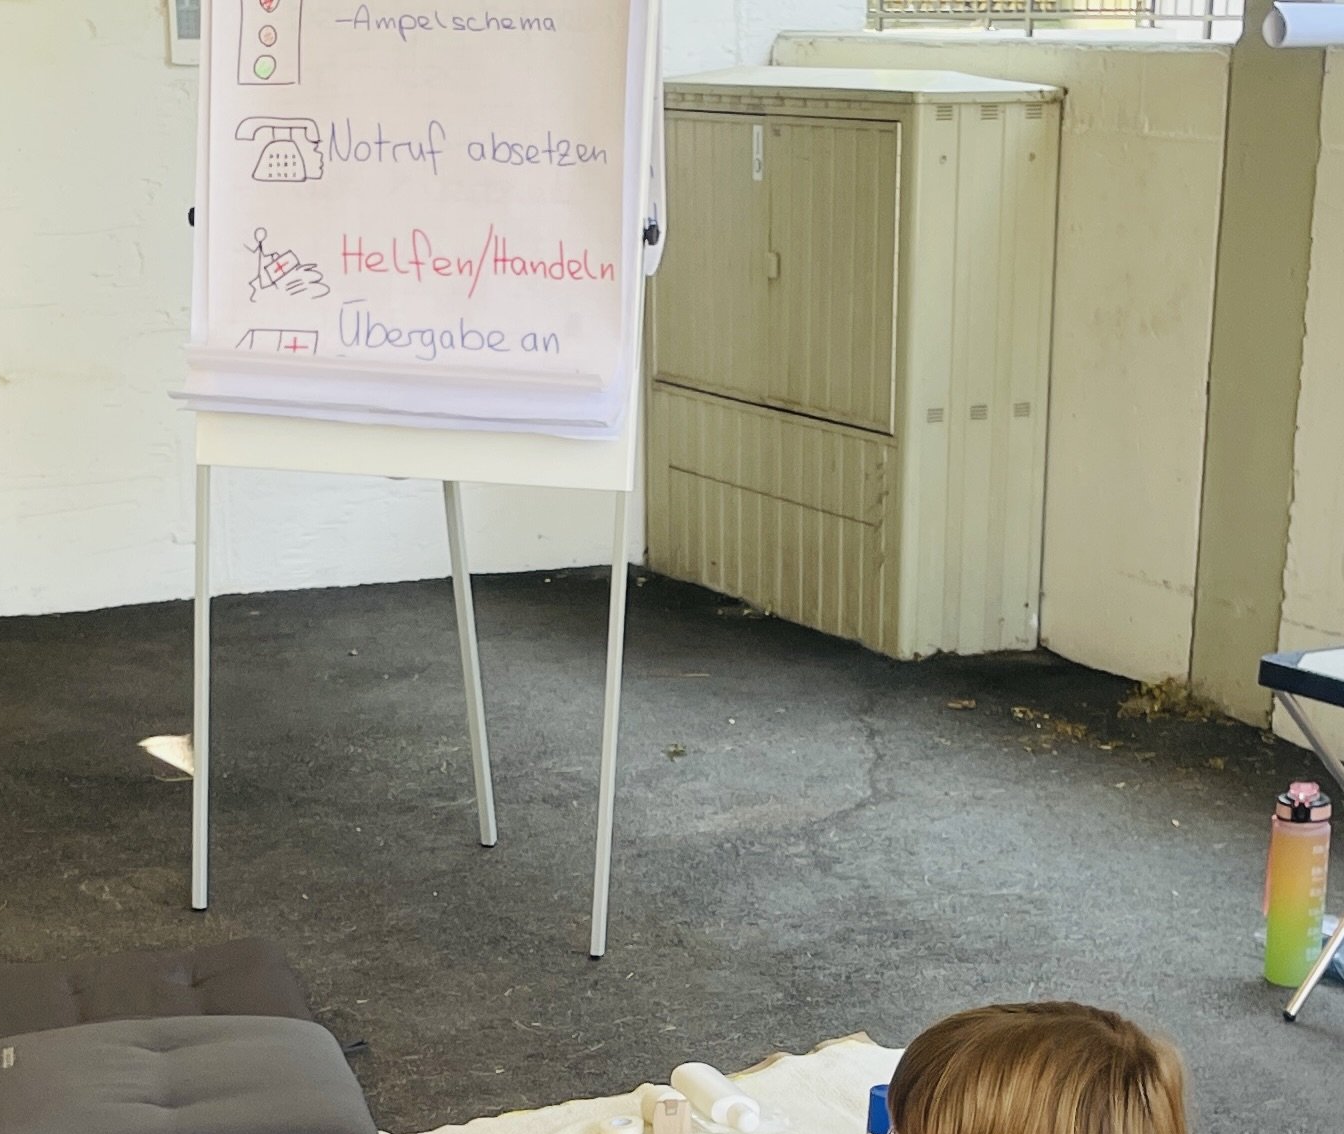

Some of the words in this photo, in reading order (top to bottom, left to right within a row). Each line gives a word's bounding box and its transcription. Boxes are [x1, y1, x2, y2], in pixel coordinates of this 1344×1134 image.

[327, 119, 447, 176] Notruf
[466, 129, 608, 167] absetzen
[341, 223, 616, 299] Helfen/Handeln
[338, 298, 511, 361] Übergabe
[520, 331, 560, 355] an
